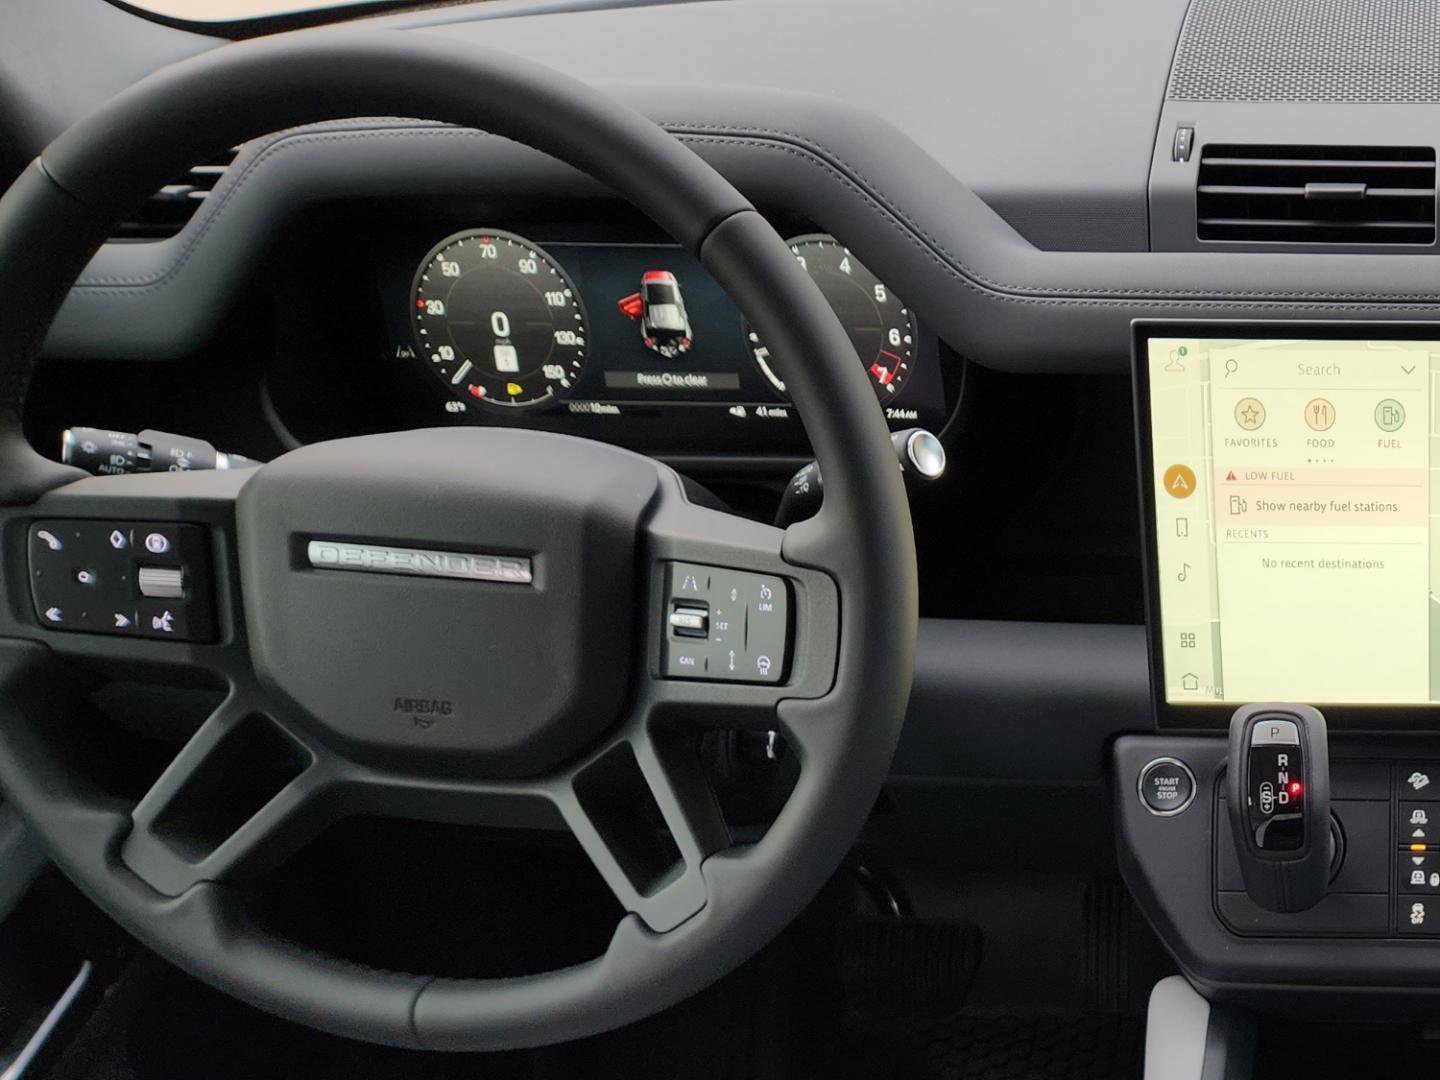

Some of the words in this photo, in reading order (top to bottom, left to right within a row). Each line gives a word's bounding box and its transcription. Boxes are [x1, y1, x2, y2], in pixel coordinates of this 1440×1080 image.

[479, 244, 498, 260] 70
[441, 261, 461, 277] 50
[518, 259, 538, 275] 90
[839, 256, 852, 275] 4
[544, 291, 566, 307] 110
[874, 284, 887, 303] 5
[425, 300, 445, 316] 30
[490, 311, 510, 338] 0
[554, 330, 577, 346] 130
[888, 327, 902, 347] 6
[542, 364, 566, 380] 150
[1297, 362, 1342, 376] Search
[1224, 438, 1279, 448] FAVORITES
[1306, 438, 1335, 448] FOOD
[1377, 439, 1402, 449] FUEL
[1245, 471, 1269, 481] LOW
[1271, 471, 1295, 481] FUEL
[1255, 500, 1286, 512] Show
[1289, 500, 1327, 514] nearby
[1329, 500, 1351, 512] fuel
[1353, 500, 1398, 513] stations
[1226, 528, 1269, 539] RECENTS
[1261, 558, 1276, 569] No
[1279, 559, 1314, 569] recent
[1317, 558, 1385, 570] destinations
[393, 697, 453, 717] AIRBAG
[1270, 727, 1279, 737] P
[1277, 753, 1288, 767] R
[1154, 777, 1180, 786] START
[1278, 771, 1289, 785] N
[1292, 783, 1300, 792] P
[1157, 791, 1178, 800] STOP
[1262, 791, 1272, 804] S
[1278, 791, 1289, 805] D
